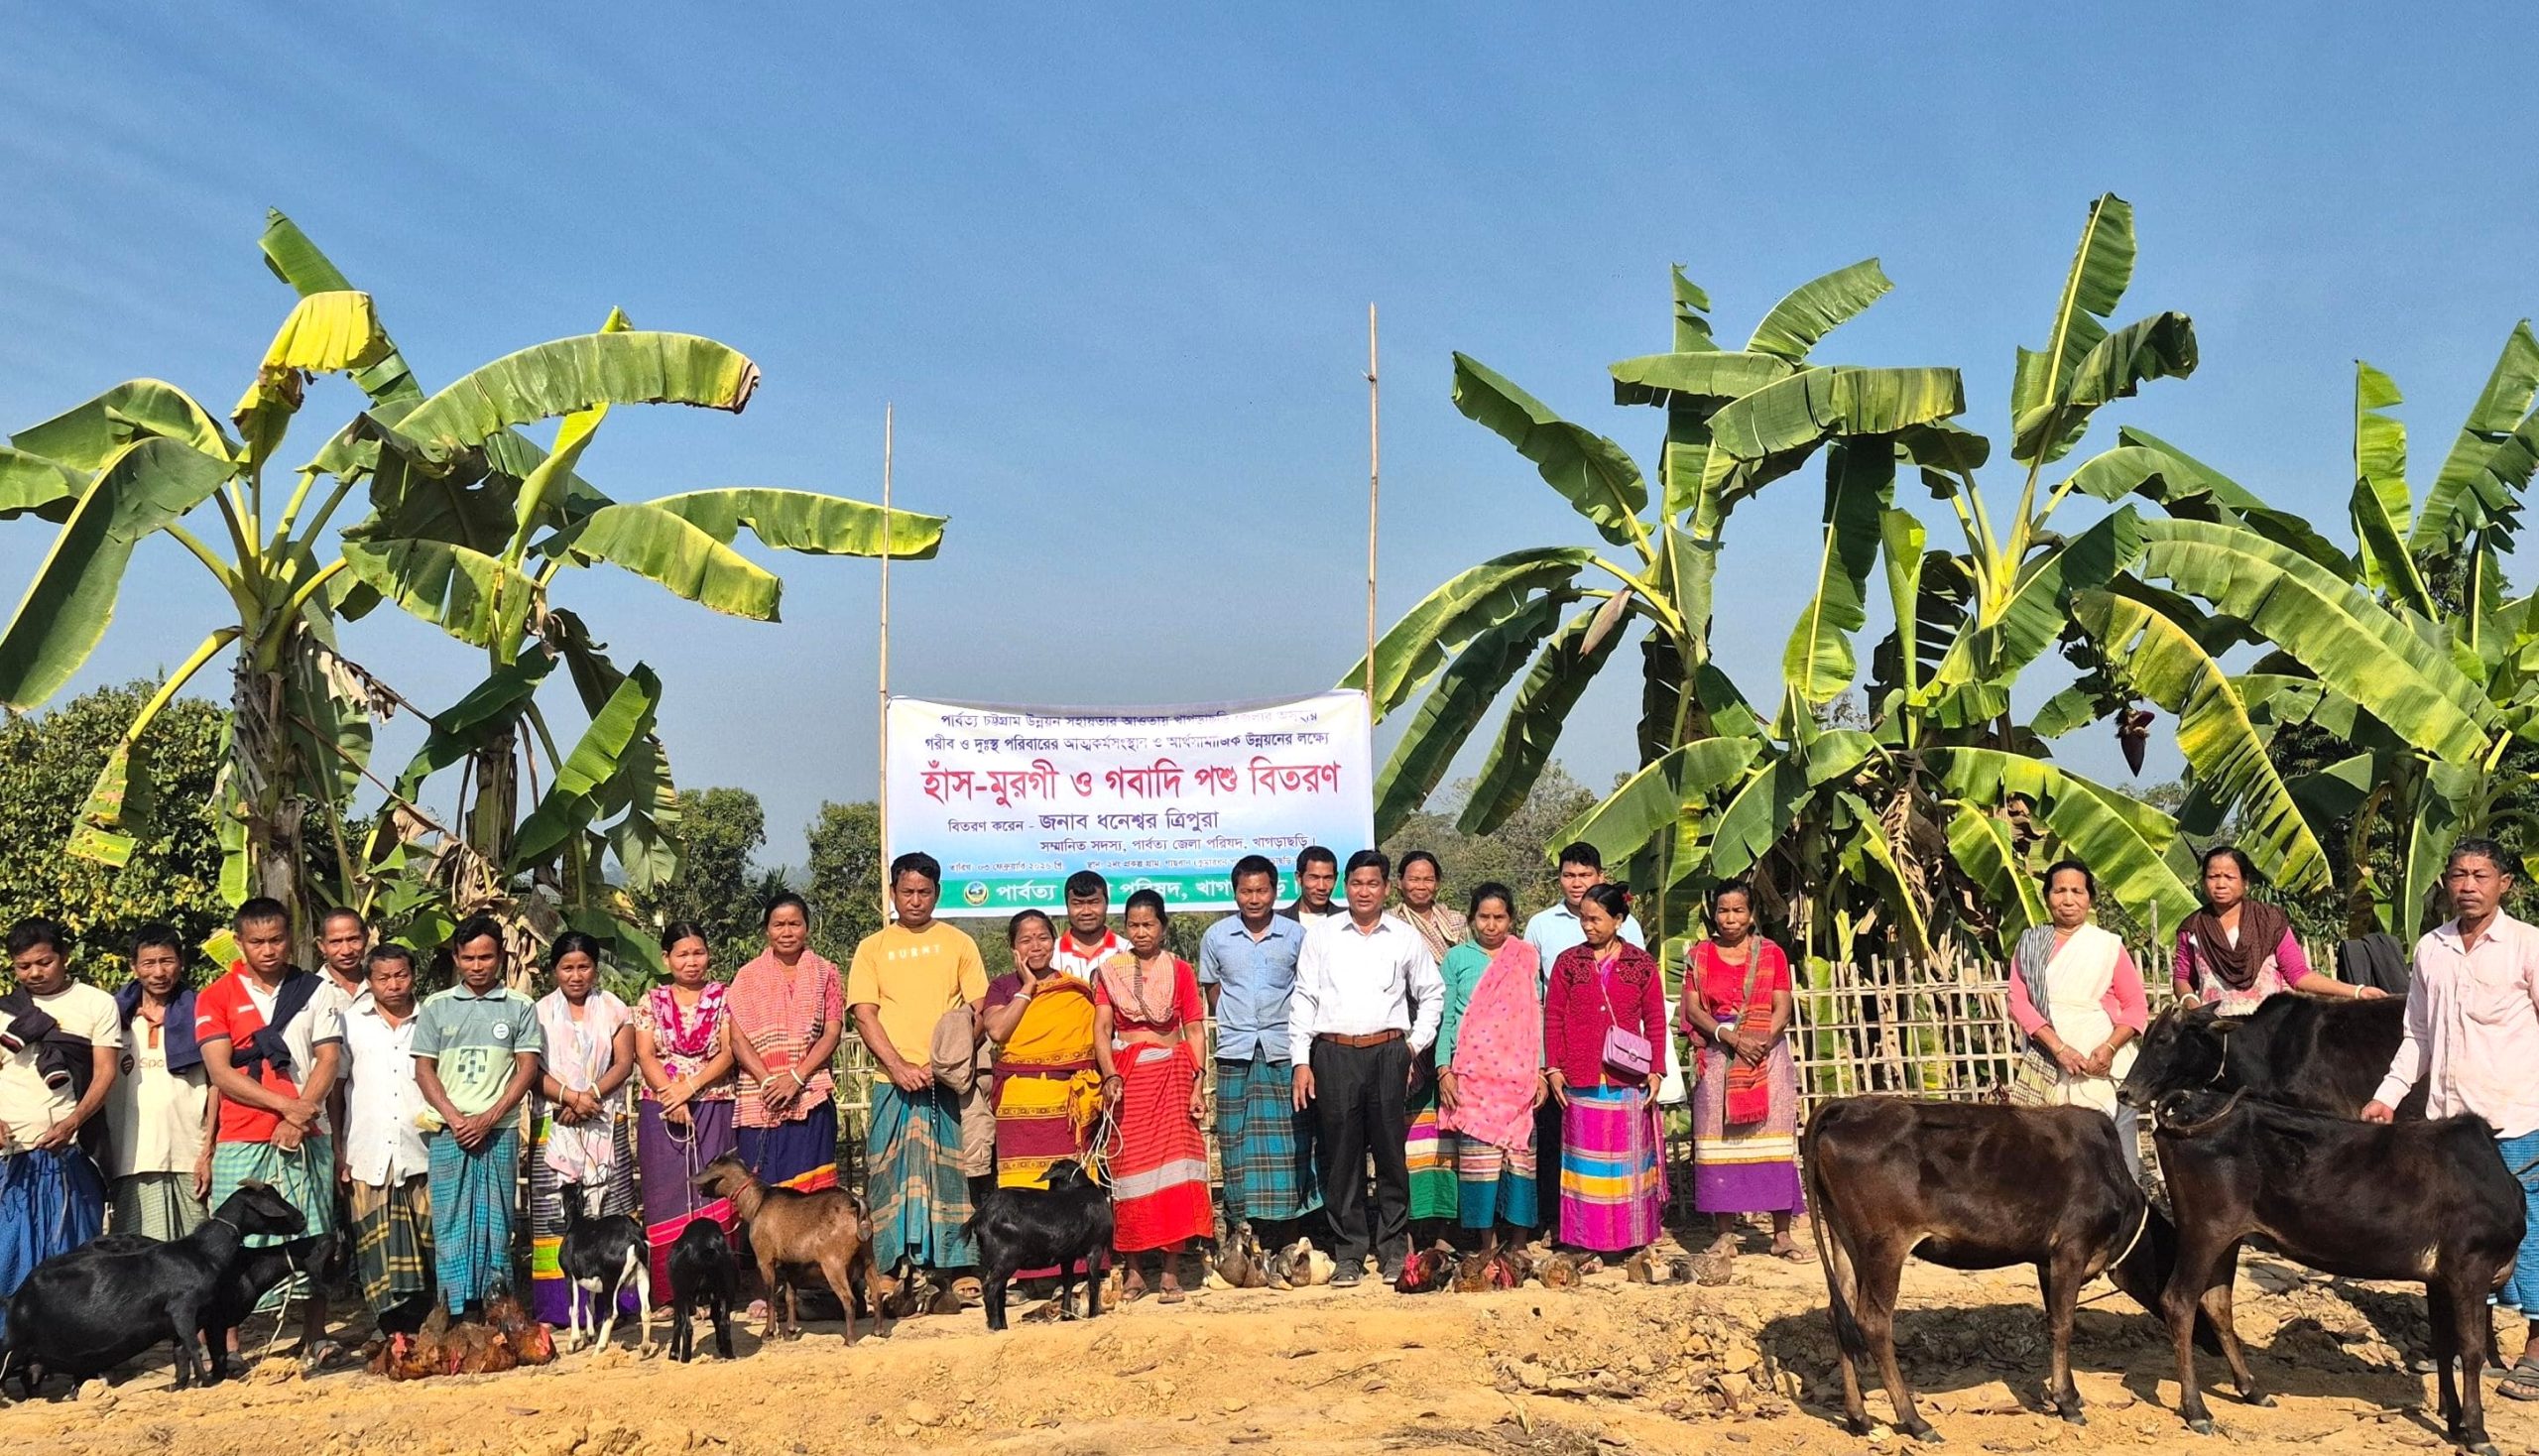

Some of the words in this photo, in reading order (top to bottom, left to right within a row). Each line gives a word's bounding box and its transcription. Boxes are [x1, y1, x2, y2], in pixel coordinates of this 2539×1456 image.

[941, 712, 979, 727] পার্বত্য
[1026, 712, 1060, 728] উন্নয়ন
[925, 734, 954, 751] গরীব
[960, 739, 969, 750] ও
[1004, 734, 1059, 751] পরিবারের
[1152, 737, 1161, 748] ও
[1246, 732, 1292, 749] উন্নয়নের
[1297, 732, 1329, 746] লক্ষ্যে
[920, 759, 1059, 808] হাঁস-মুরগী
[1070, 772, 1092, 796] ও
[1105, 758, 1184, 798] গবাদি
[1195, 765, 1238, 795] পশু
[1248, 756, 1342, 795] বিতরণ
[948, 818, 986, 832] বিতরণ
[992, 820, 1024, 832] করেন
[1038, 813, 1089, 831] জনাব
[1097, 812, 1158, 831] ধনেশ্বর
[1165, 807, 1219, 833] ত্রিপুরা
[1040, 838, 1087, 852] সম্মানিত
[1132, 838, 1167, 850] পার্বত্য
[1172, 838, 1201, 850] জেলা
[996, 880, 1057, 902] পার্বত্য
